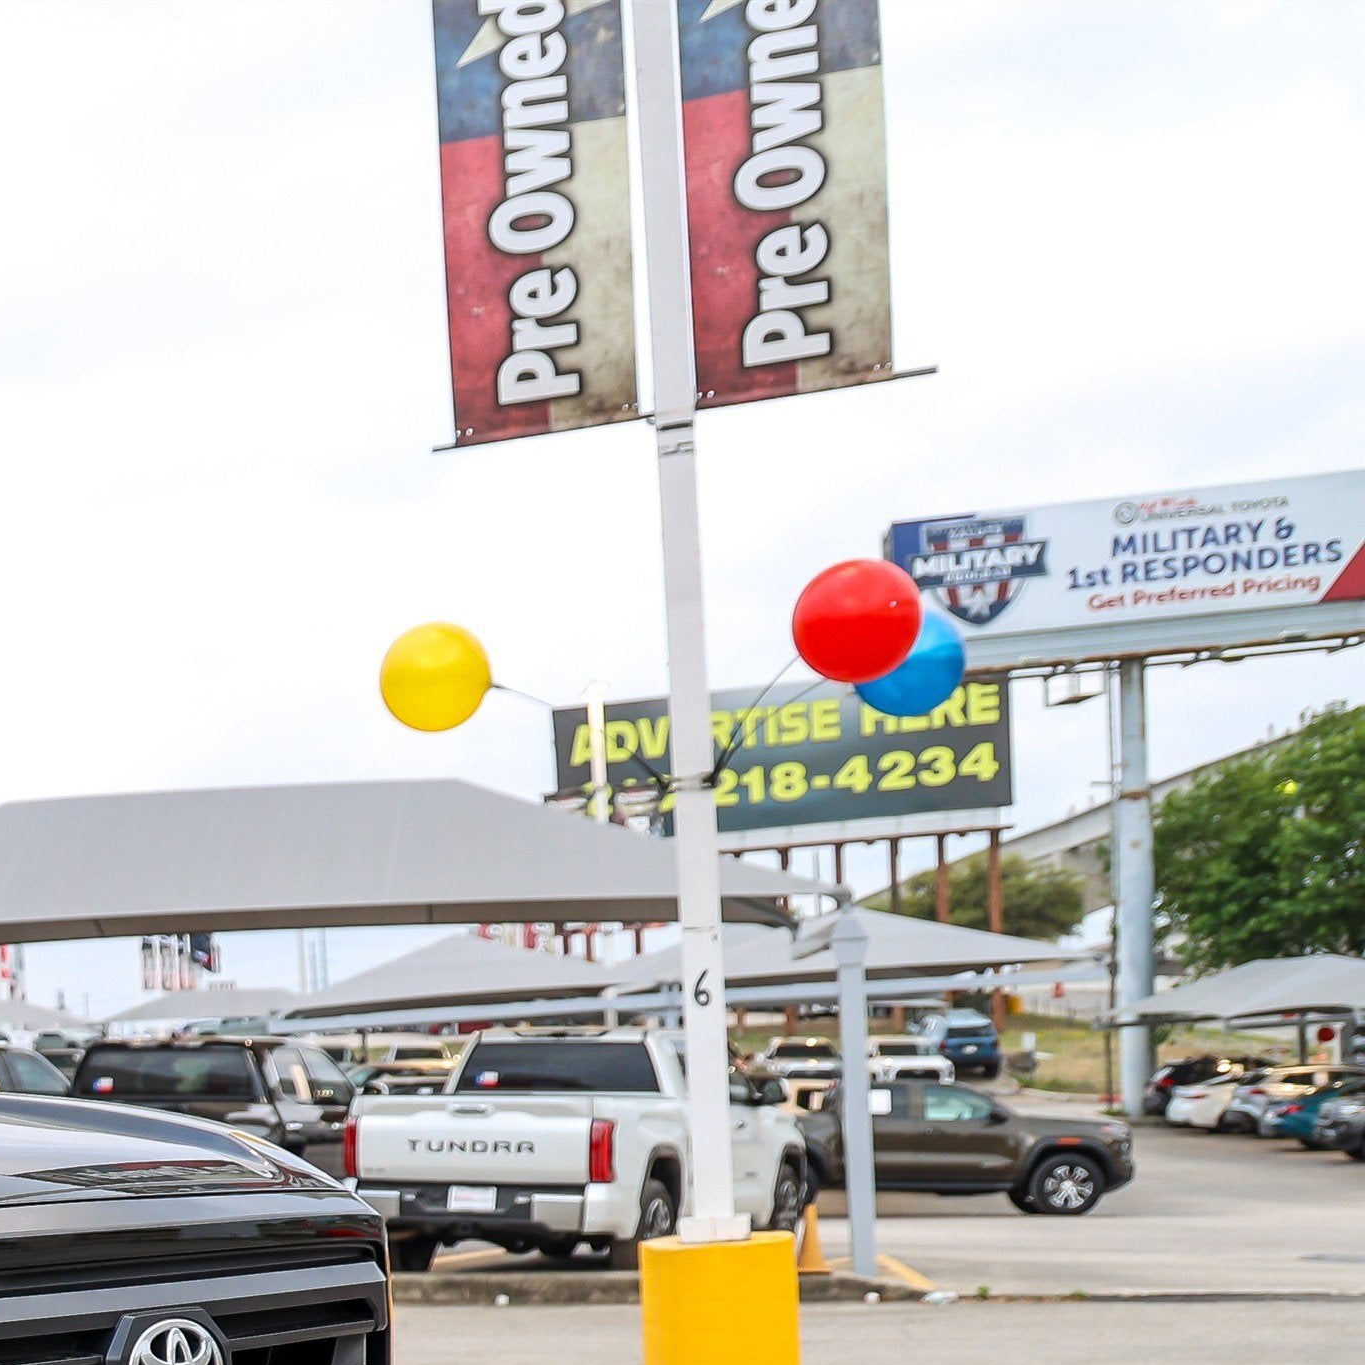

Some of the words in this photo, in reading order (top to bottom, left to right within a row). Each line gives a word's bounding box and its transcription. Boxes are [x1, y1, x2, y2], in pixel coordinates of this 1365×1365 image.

[744, 223, 830, 366] Pre
[499, 267, 578, 404] Pre
[1112, 520, 1265, 558] MILITARY
[912, 540, 1044, 578] MILITARY
[1069, 567, 1112, 590] 1st
[1123, 539, 1343, 584] RESPONDERS
[1133, 583, 1235, 605] Preferred
[1243, 575, 1321, 594] Pricing
[570, 697, 842, 767] ADVRTISE
[694, 968, 711, 1006] 6
[407, 1139, 534, 1154] TUNDRA
